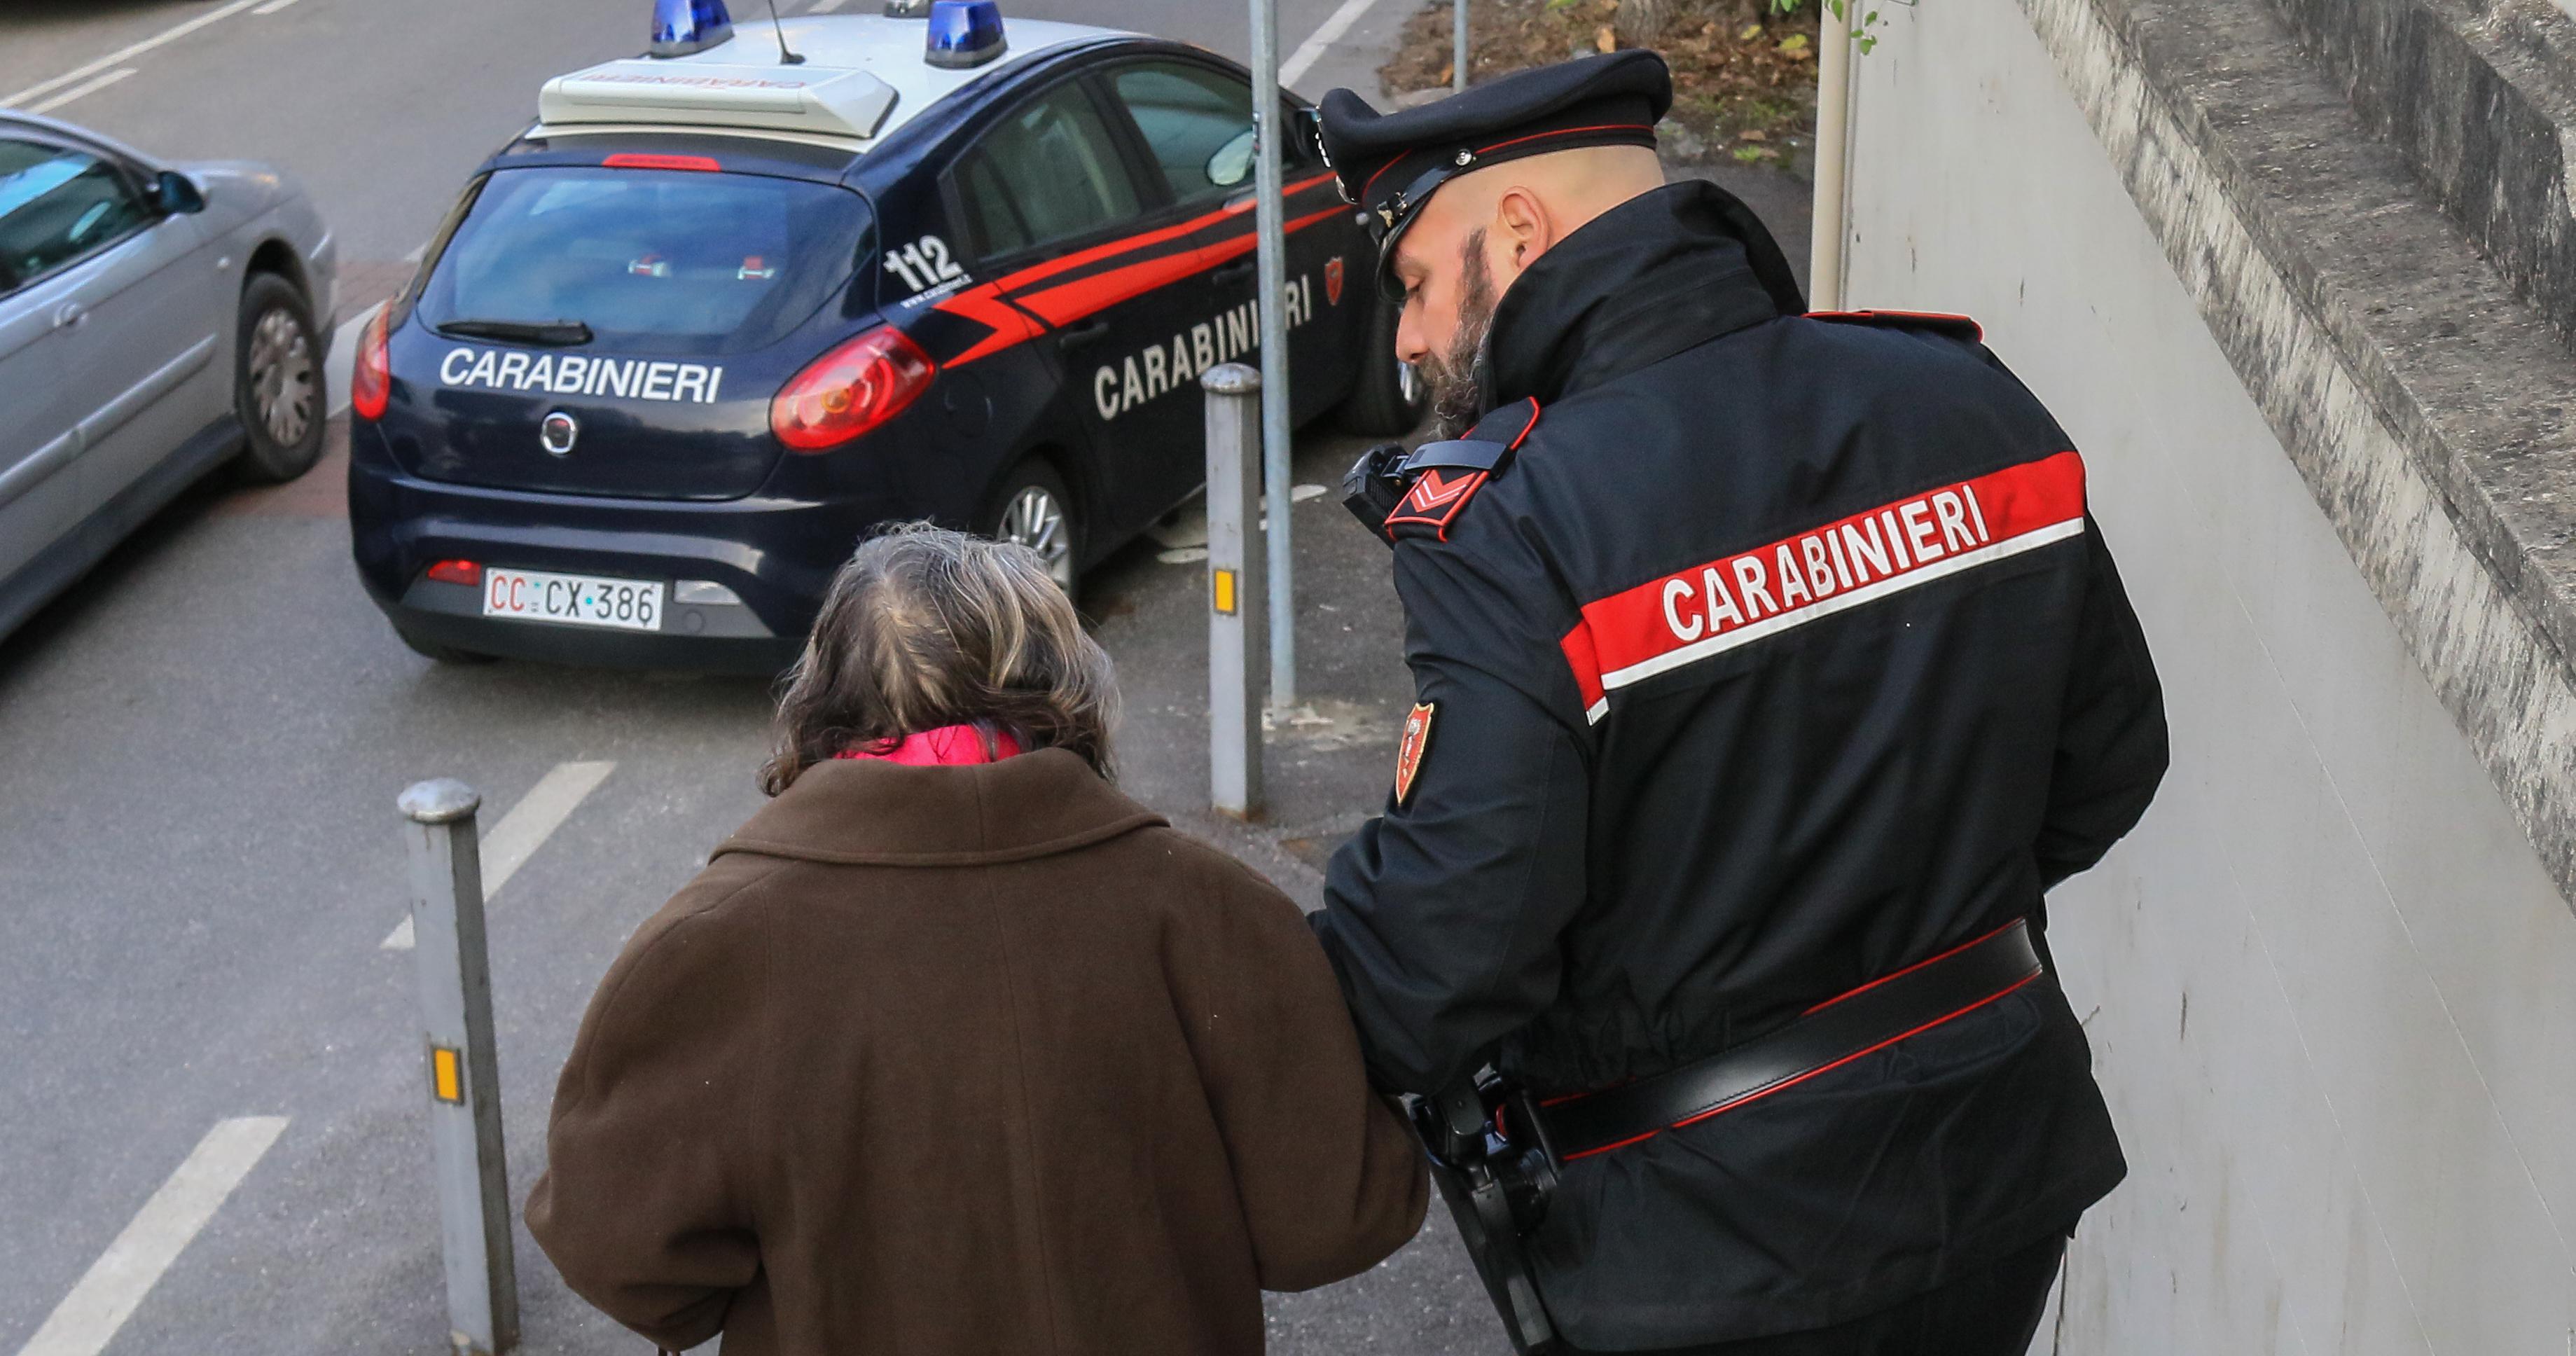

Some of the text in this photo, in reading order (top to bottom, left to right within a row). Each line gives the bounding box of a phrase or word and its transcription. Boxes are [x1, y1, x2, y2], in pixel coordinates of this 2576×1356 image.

[882, 235, 964, 292] 112
[440, 347, 723, 404] CARABINIERI
[1094, 274, 1311, 420] CARABINIRI
[1663, 483, 1990, 642] CARABINIERI
[490, 575, 653, 623] CC CX 386
